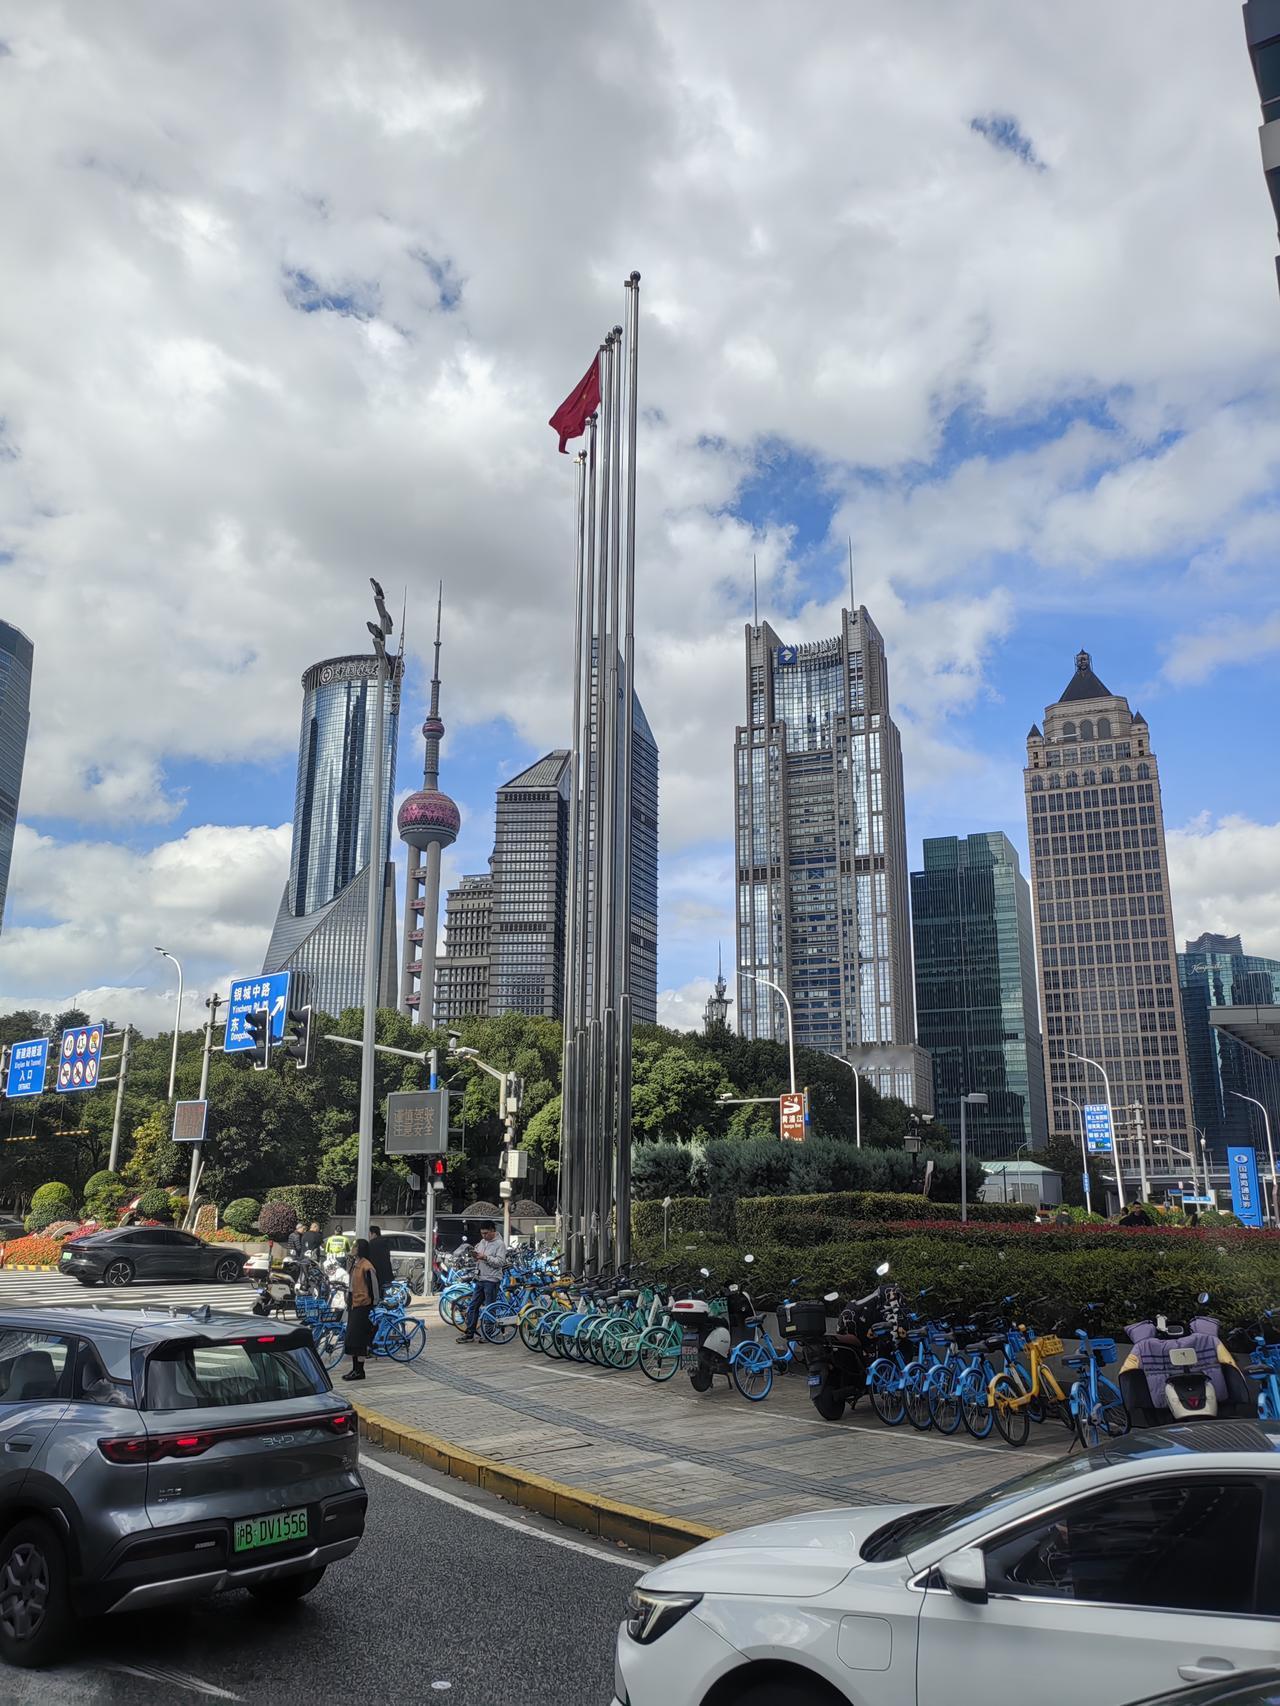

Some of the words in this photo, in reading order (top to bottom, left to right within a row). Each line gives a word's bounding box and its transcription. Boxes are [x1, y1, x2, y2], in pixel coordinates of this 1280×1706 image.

[234, 983, 270, 1001] 银城中路
[232, 1005, 252, 1014] Yincheng
[16, 1045, 42, 1060] 新建路隧道
[19, 1070, 33, 1081] 入口
[782, 1114, 803, 1124] 黄浦江
[262, 1435, 294, 1446] BYD
